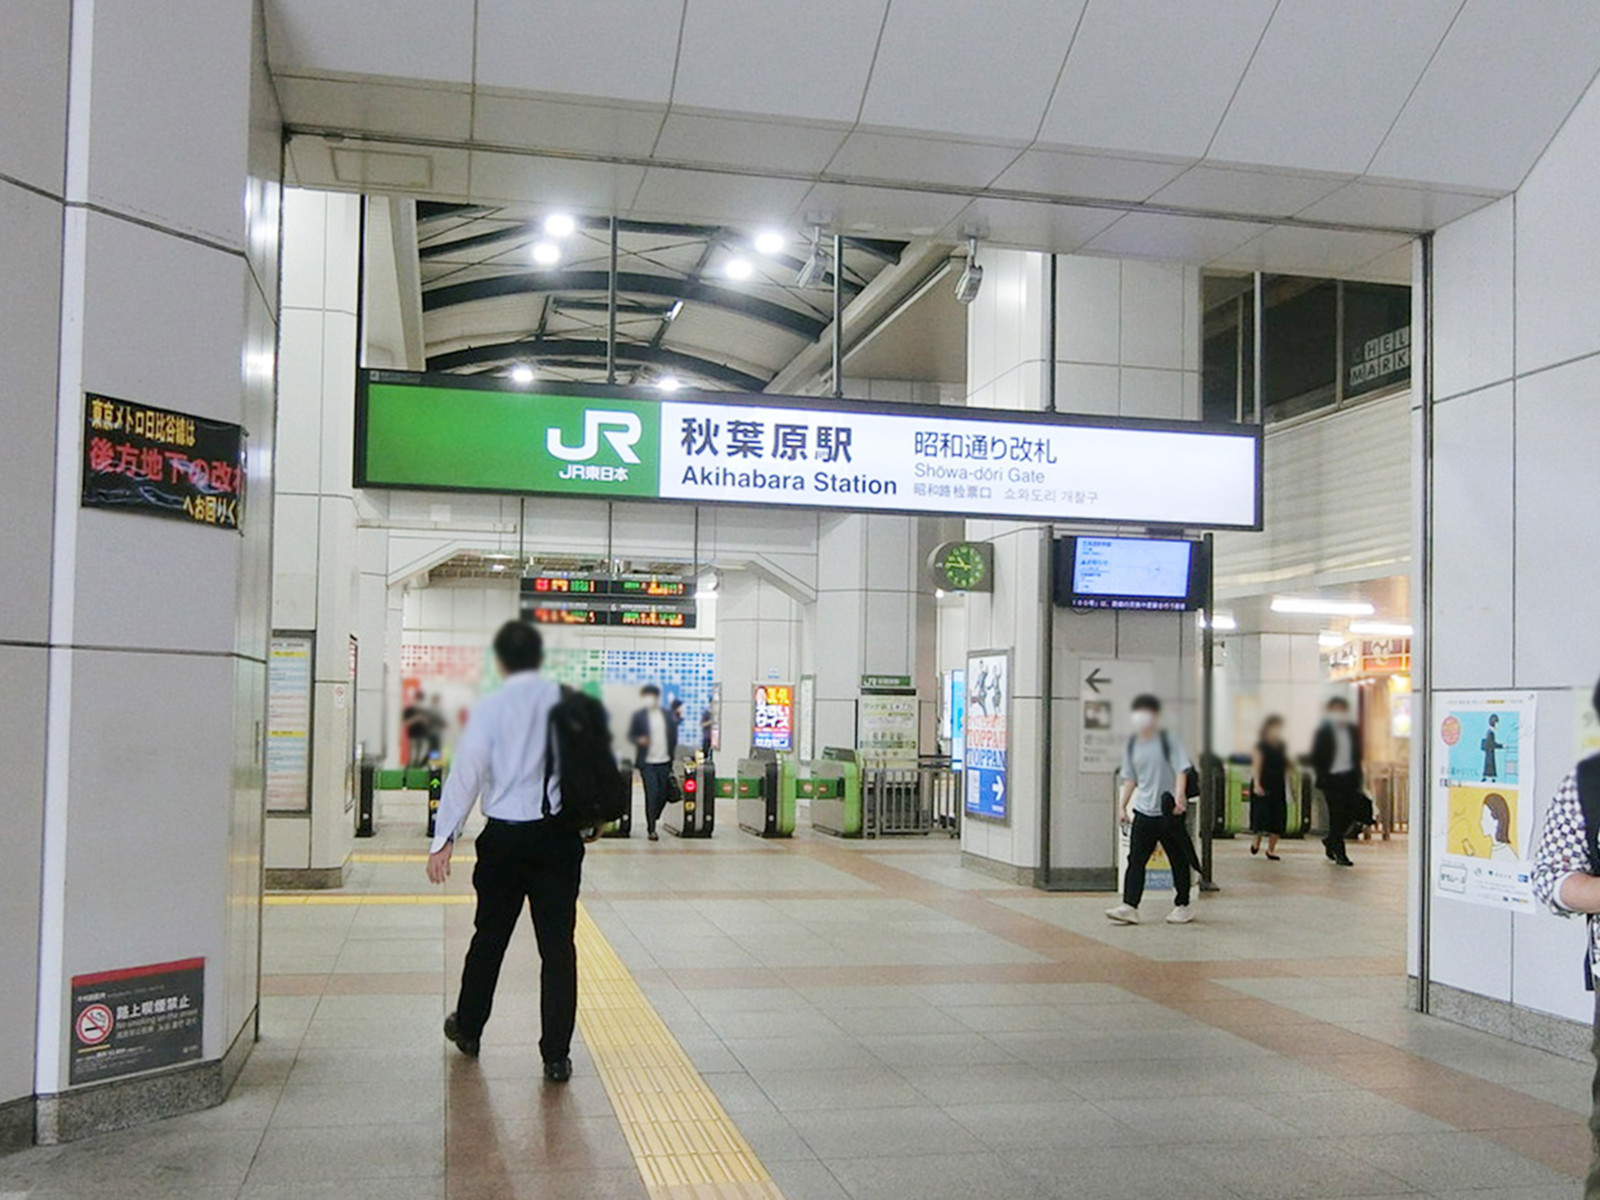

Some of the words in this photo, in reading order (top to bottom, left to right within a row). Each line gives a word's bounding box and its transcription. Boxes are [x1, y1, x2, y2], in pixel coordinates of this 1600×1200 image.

[91, 399, 196, 447] 東京メトロ日比谷線は
[546, 409, 642, 464] JR
[681, 417, 852, 463] 秋葉原駅
[914, 431, 1057, 464] 昭和通り改札
[558, 464, 629, 482] JR東日本
[681, 466, 805, 491] Akihabara
[814, 471, 897, 495] Station
[1008, 467, 1046, 484] Gate
